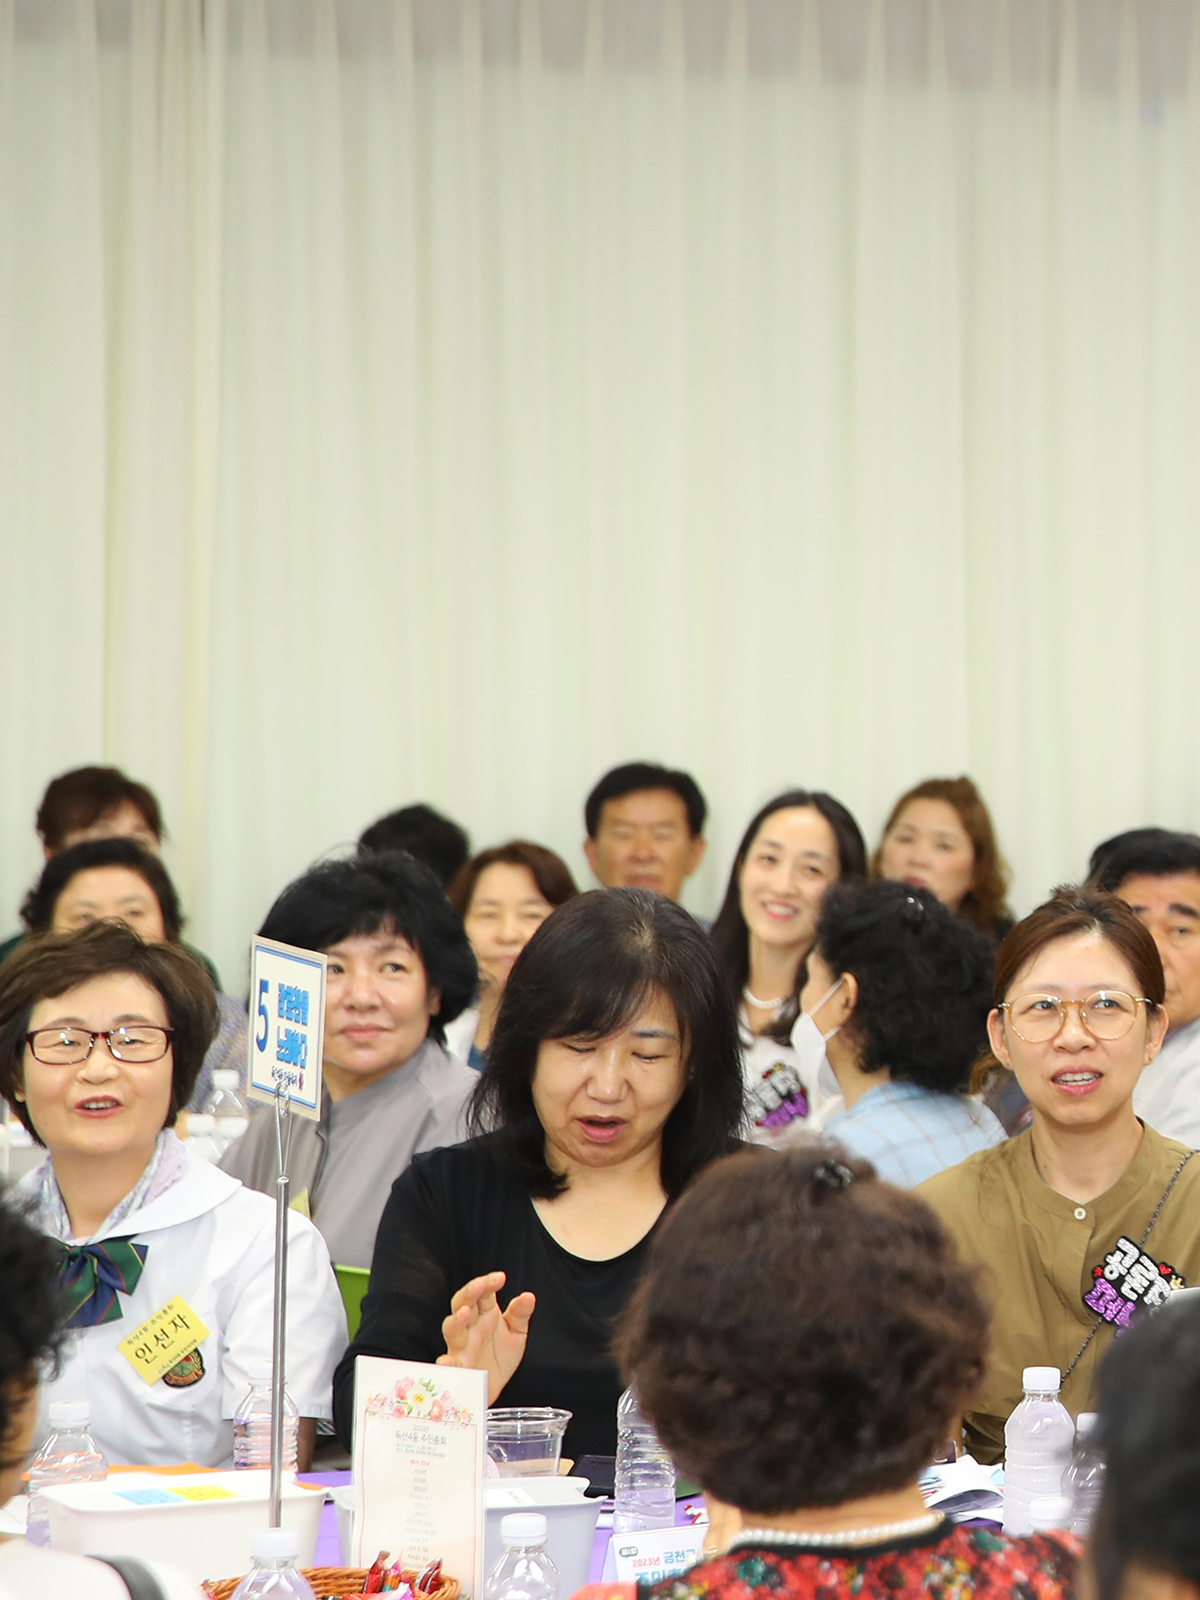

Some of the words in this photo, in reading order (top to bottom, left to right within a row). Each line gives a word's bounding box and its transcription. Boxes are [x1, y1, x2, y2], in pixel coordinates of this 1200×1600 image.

[256, 978, 270, 1053] 5
[135, 1314, 191, 1364] 인선자
[396, 1430, 418, 1442] 독산4동
[421, 1434, 447, 1445] 주민총회
[632, 1557, 660, 1568] 2023년
